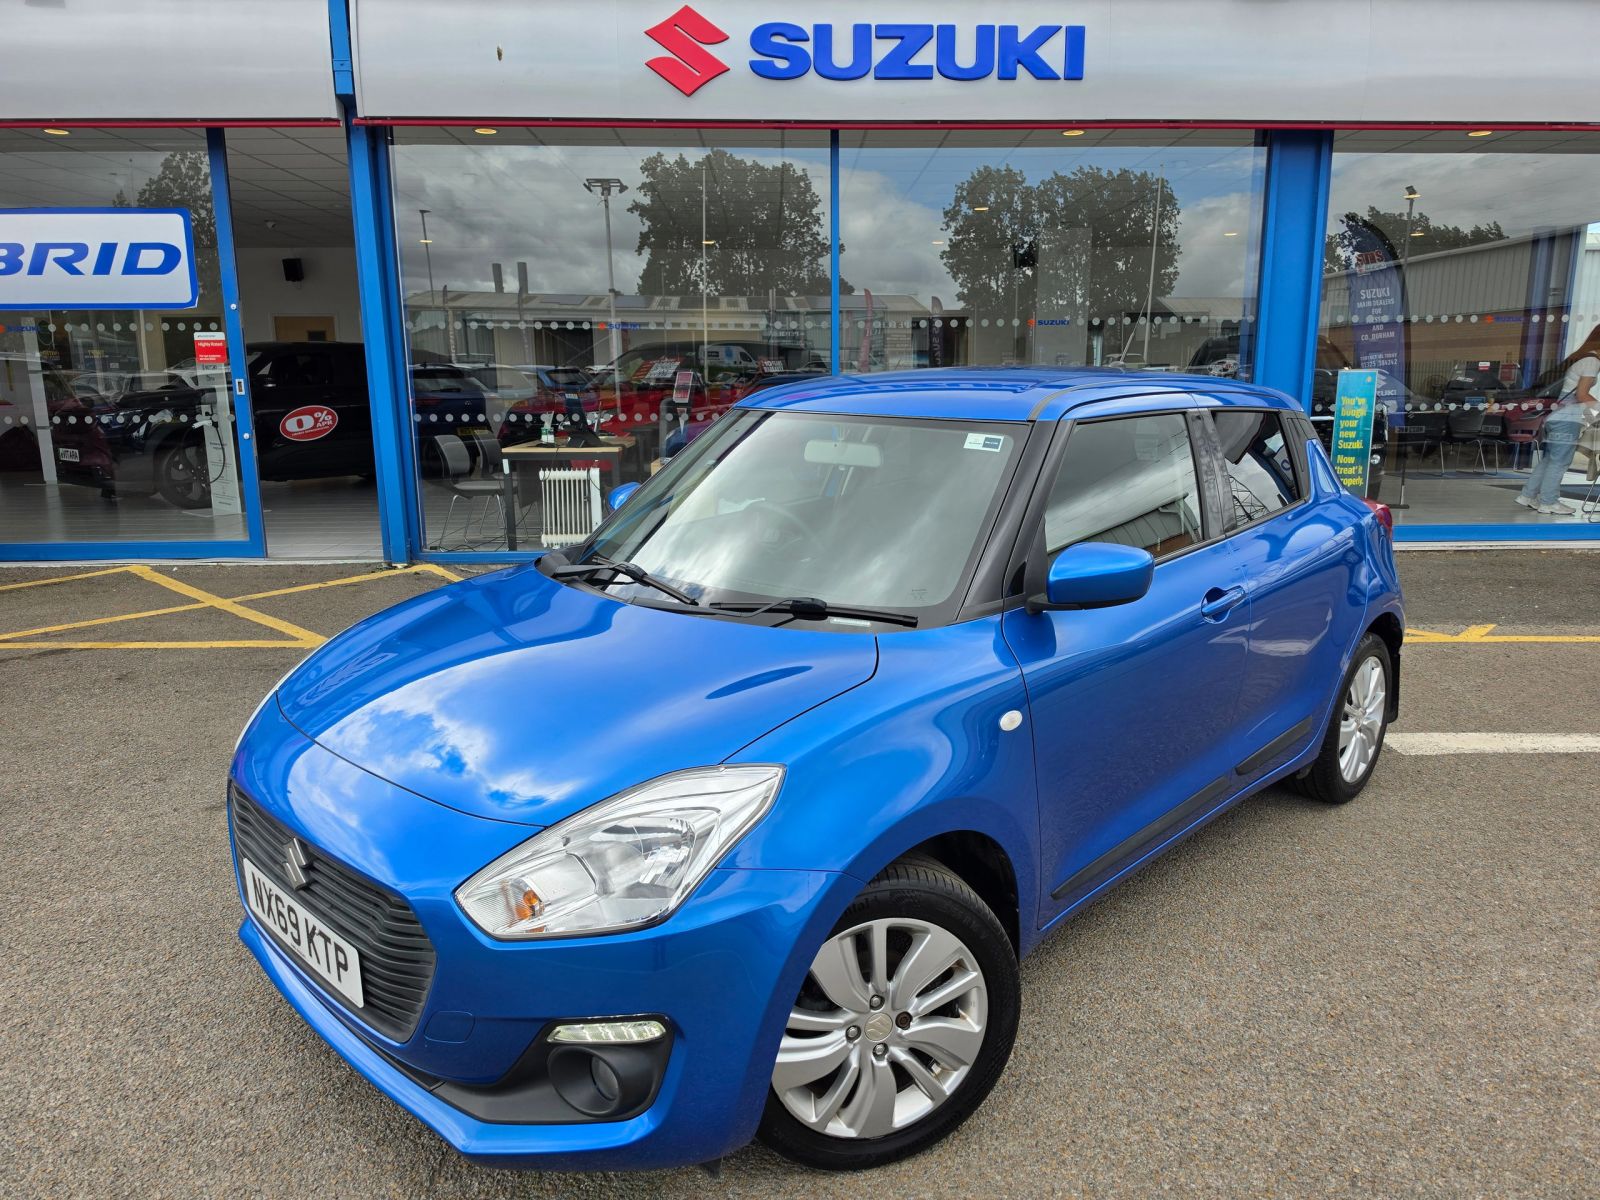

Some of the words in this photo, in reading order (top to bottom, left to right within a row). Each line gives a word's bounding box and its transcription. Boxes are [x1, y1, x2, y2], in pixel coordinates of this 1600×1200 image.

[749, 22, 1085, 81] SUZUKI
[1360, 287, 1390, 299] SUZUKI
[1372, 331, 1395, 340] DURHAM
[1340, 420, 1358, 429] your
[1339, 431, 1356, 439] new
[1338, 440, 1363, 449] Suzuki.
[1337, 455, 1355, 464] Now
[251, 871, 301, 947] NX69
[305, 917, 349, 983] KTP
